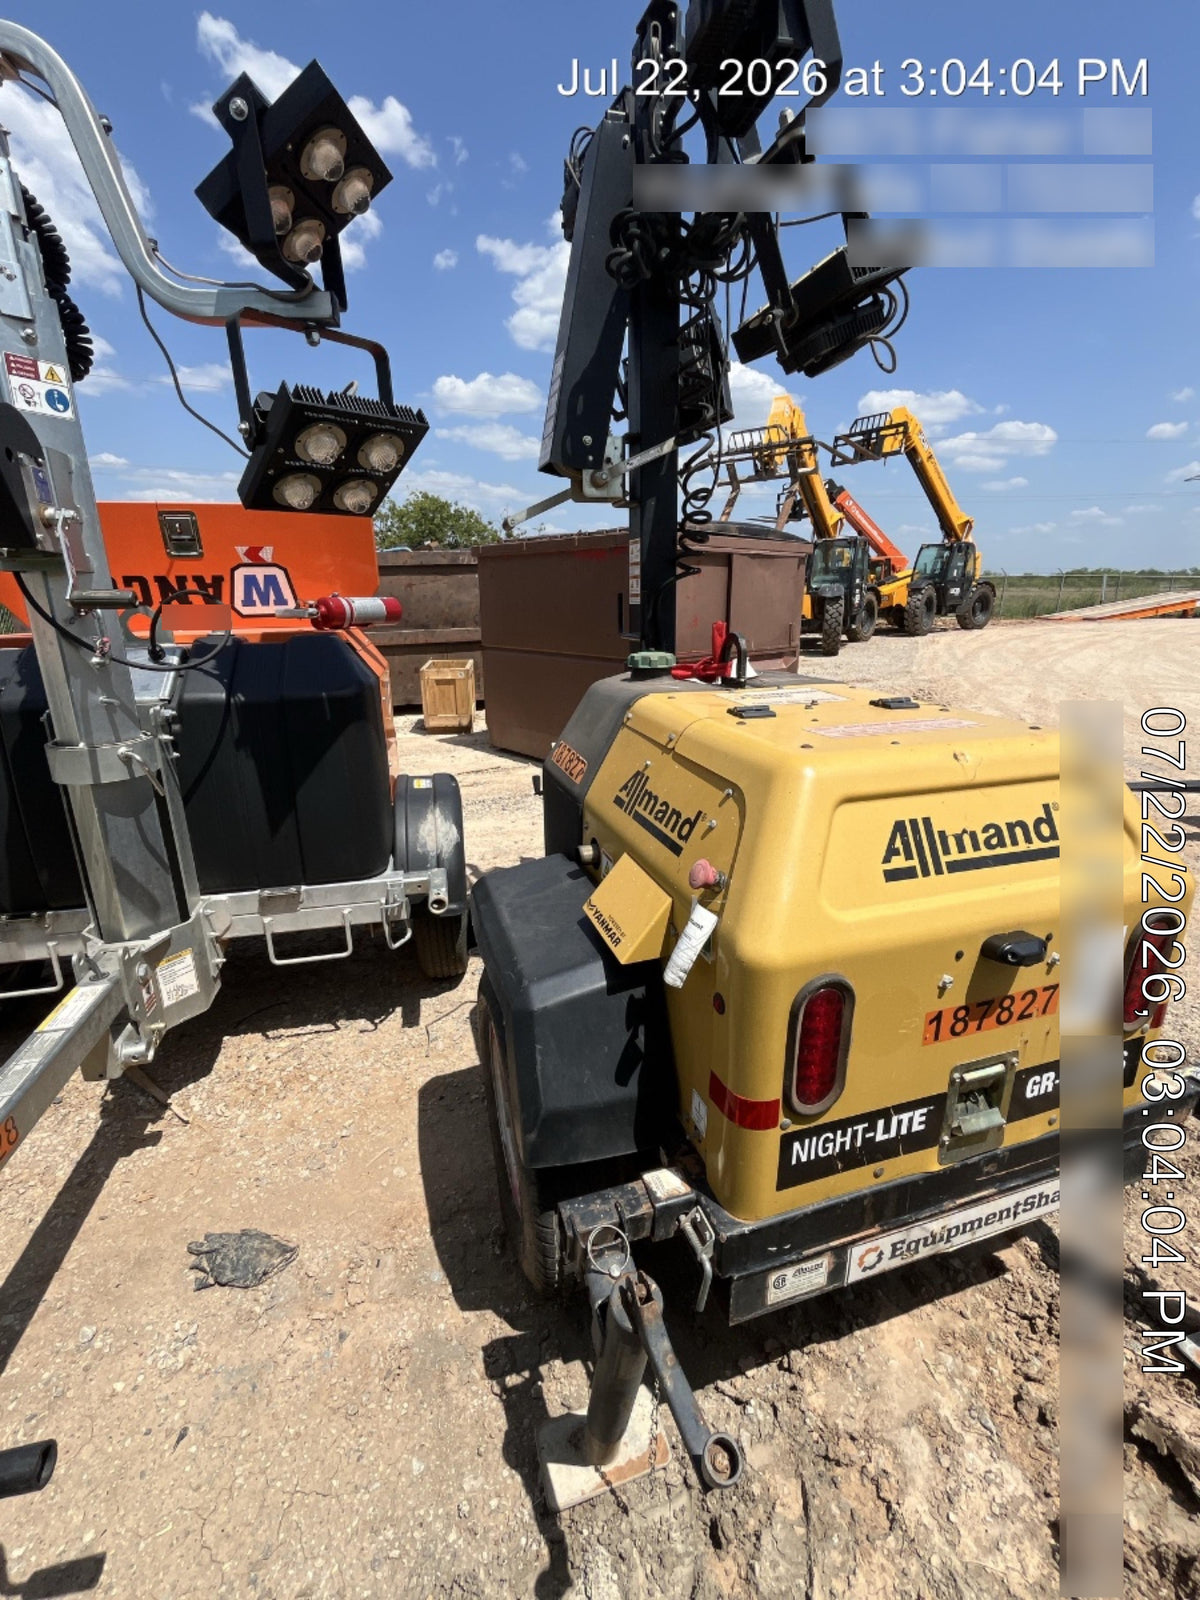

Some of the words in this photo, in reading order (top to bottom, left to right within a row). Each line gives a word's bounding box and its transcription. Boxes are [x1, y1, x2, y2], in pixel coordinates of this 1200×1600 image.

[111, 573, 289, 608] WANC
[617, 769, 703, 844] Allmand
[881, 802, 1059, 879] Allmand
[592, 907, 622, 948] YANMAR
[925, 983, 1059, 1042] 187827
[791, 1107, 929, 1166] NIGHT-LITE
[888, 1188, 1060, 1262] EquipmentSha
